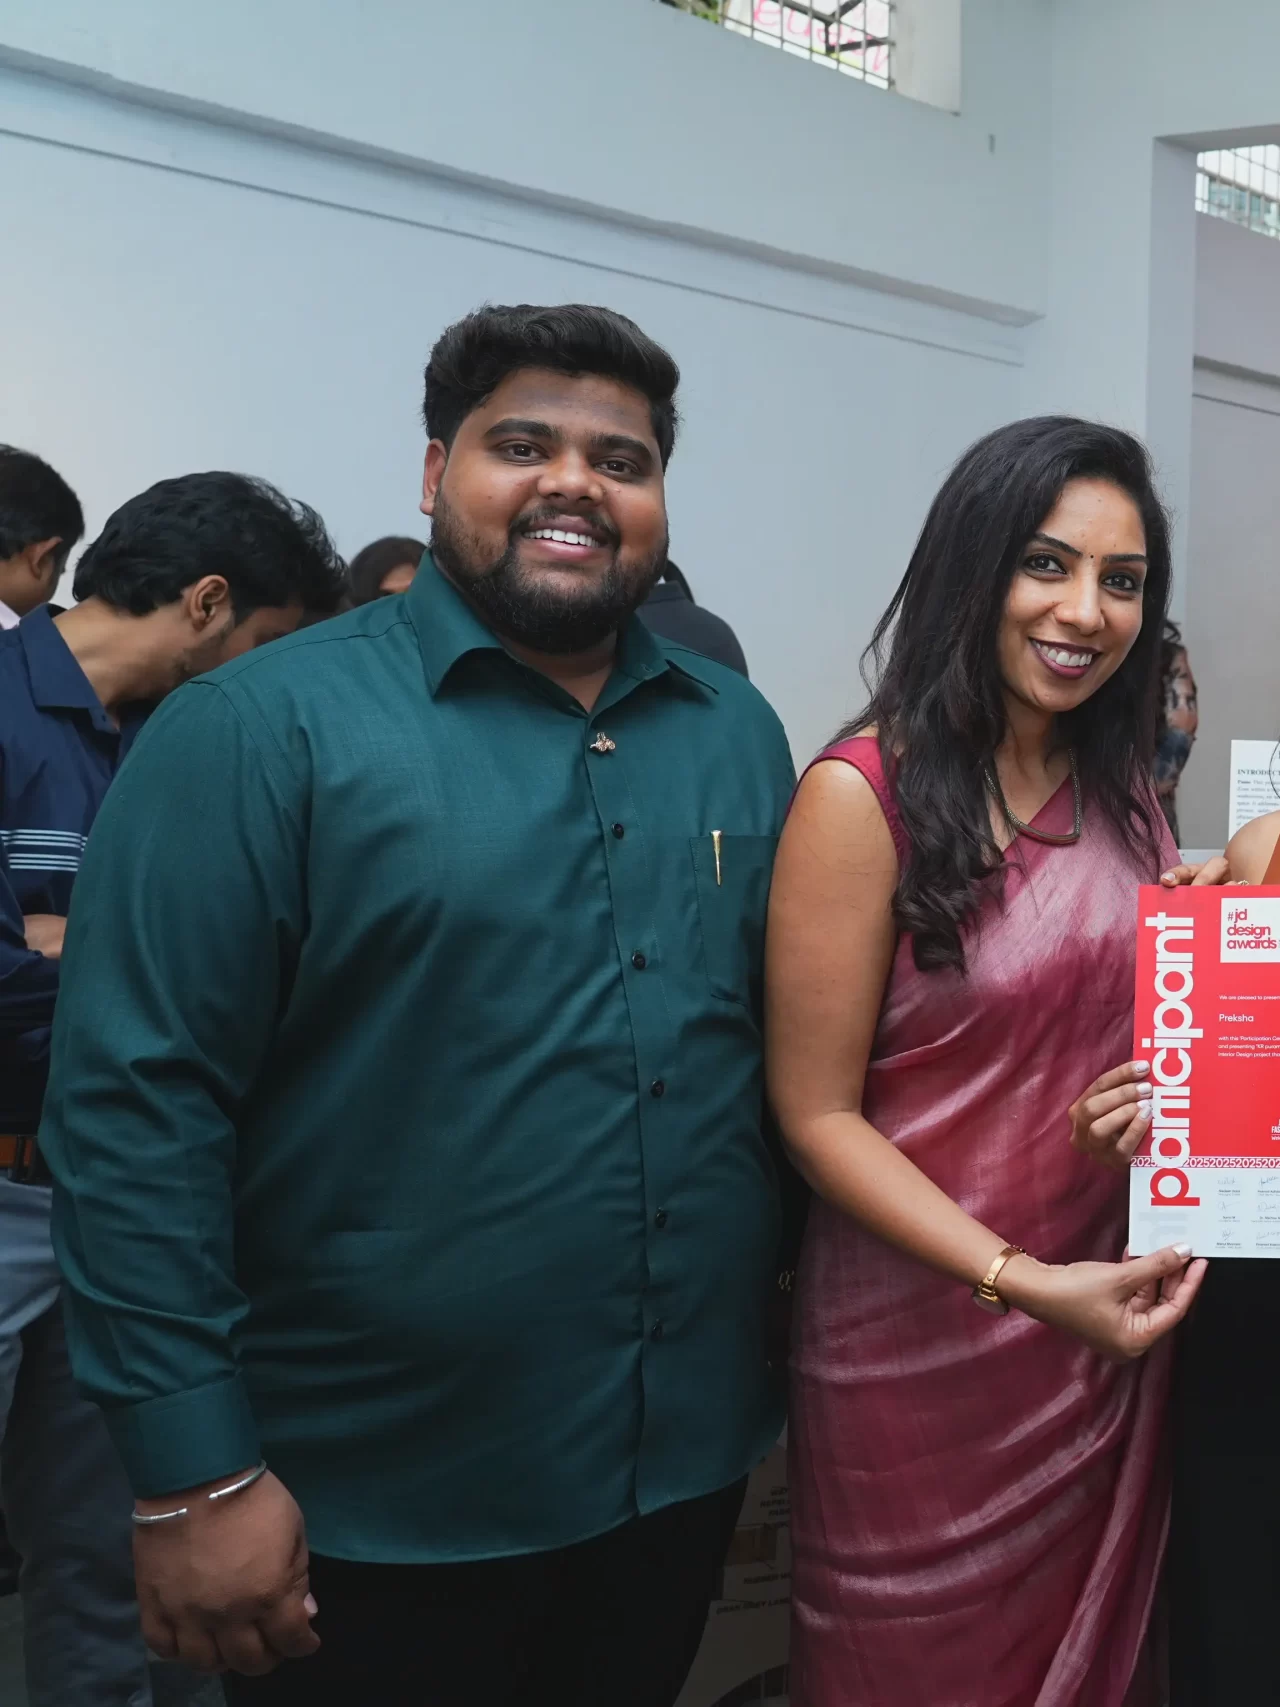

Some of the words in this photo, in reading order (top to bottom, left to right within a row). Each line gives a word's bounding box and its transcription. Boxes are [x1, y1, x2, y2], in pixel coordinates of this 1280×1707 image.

[1227, 908, 1248, 924] #jd
[1226, 923, 1271, 939] design
[1226, 937, 1278, 950] awards
[1219, 1013, 1254, 1022] Preksha
[1141, 912, 1204, 1206] participant
